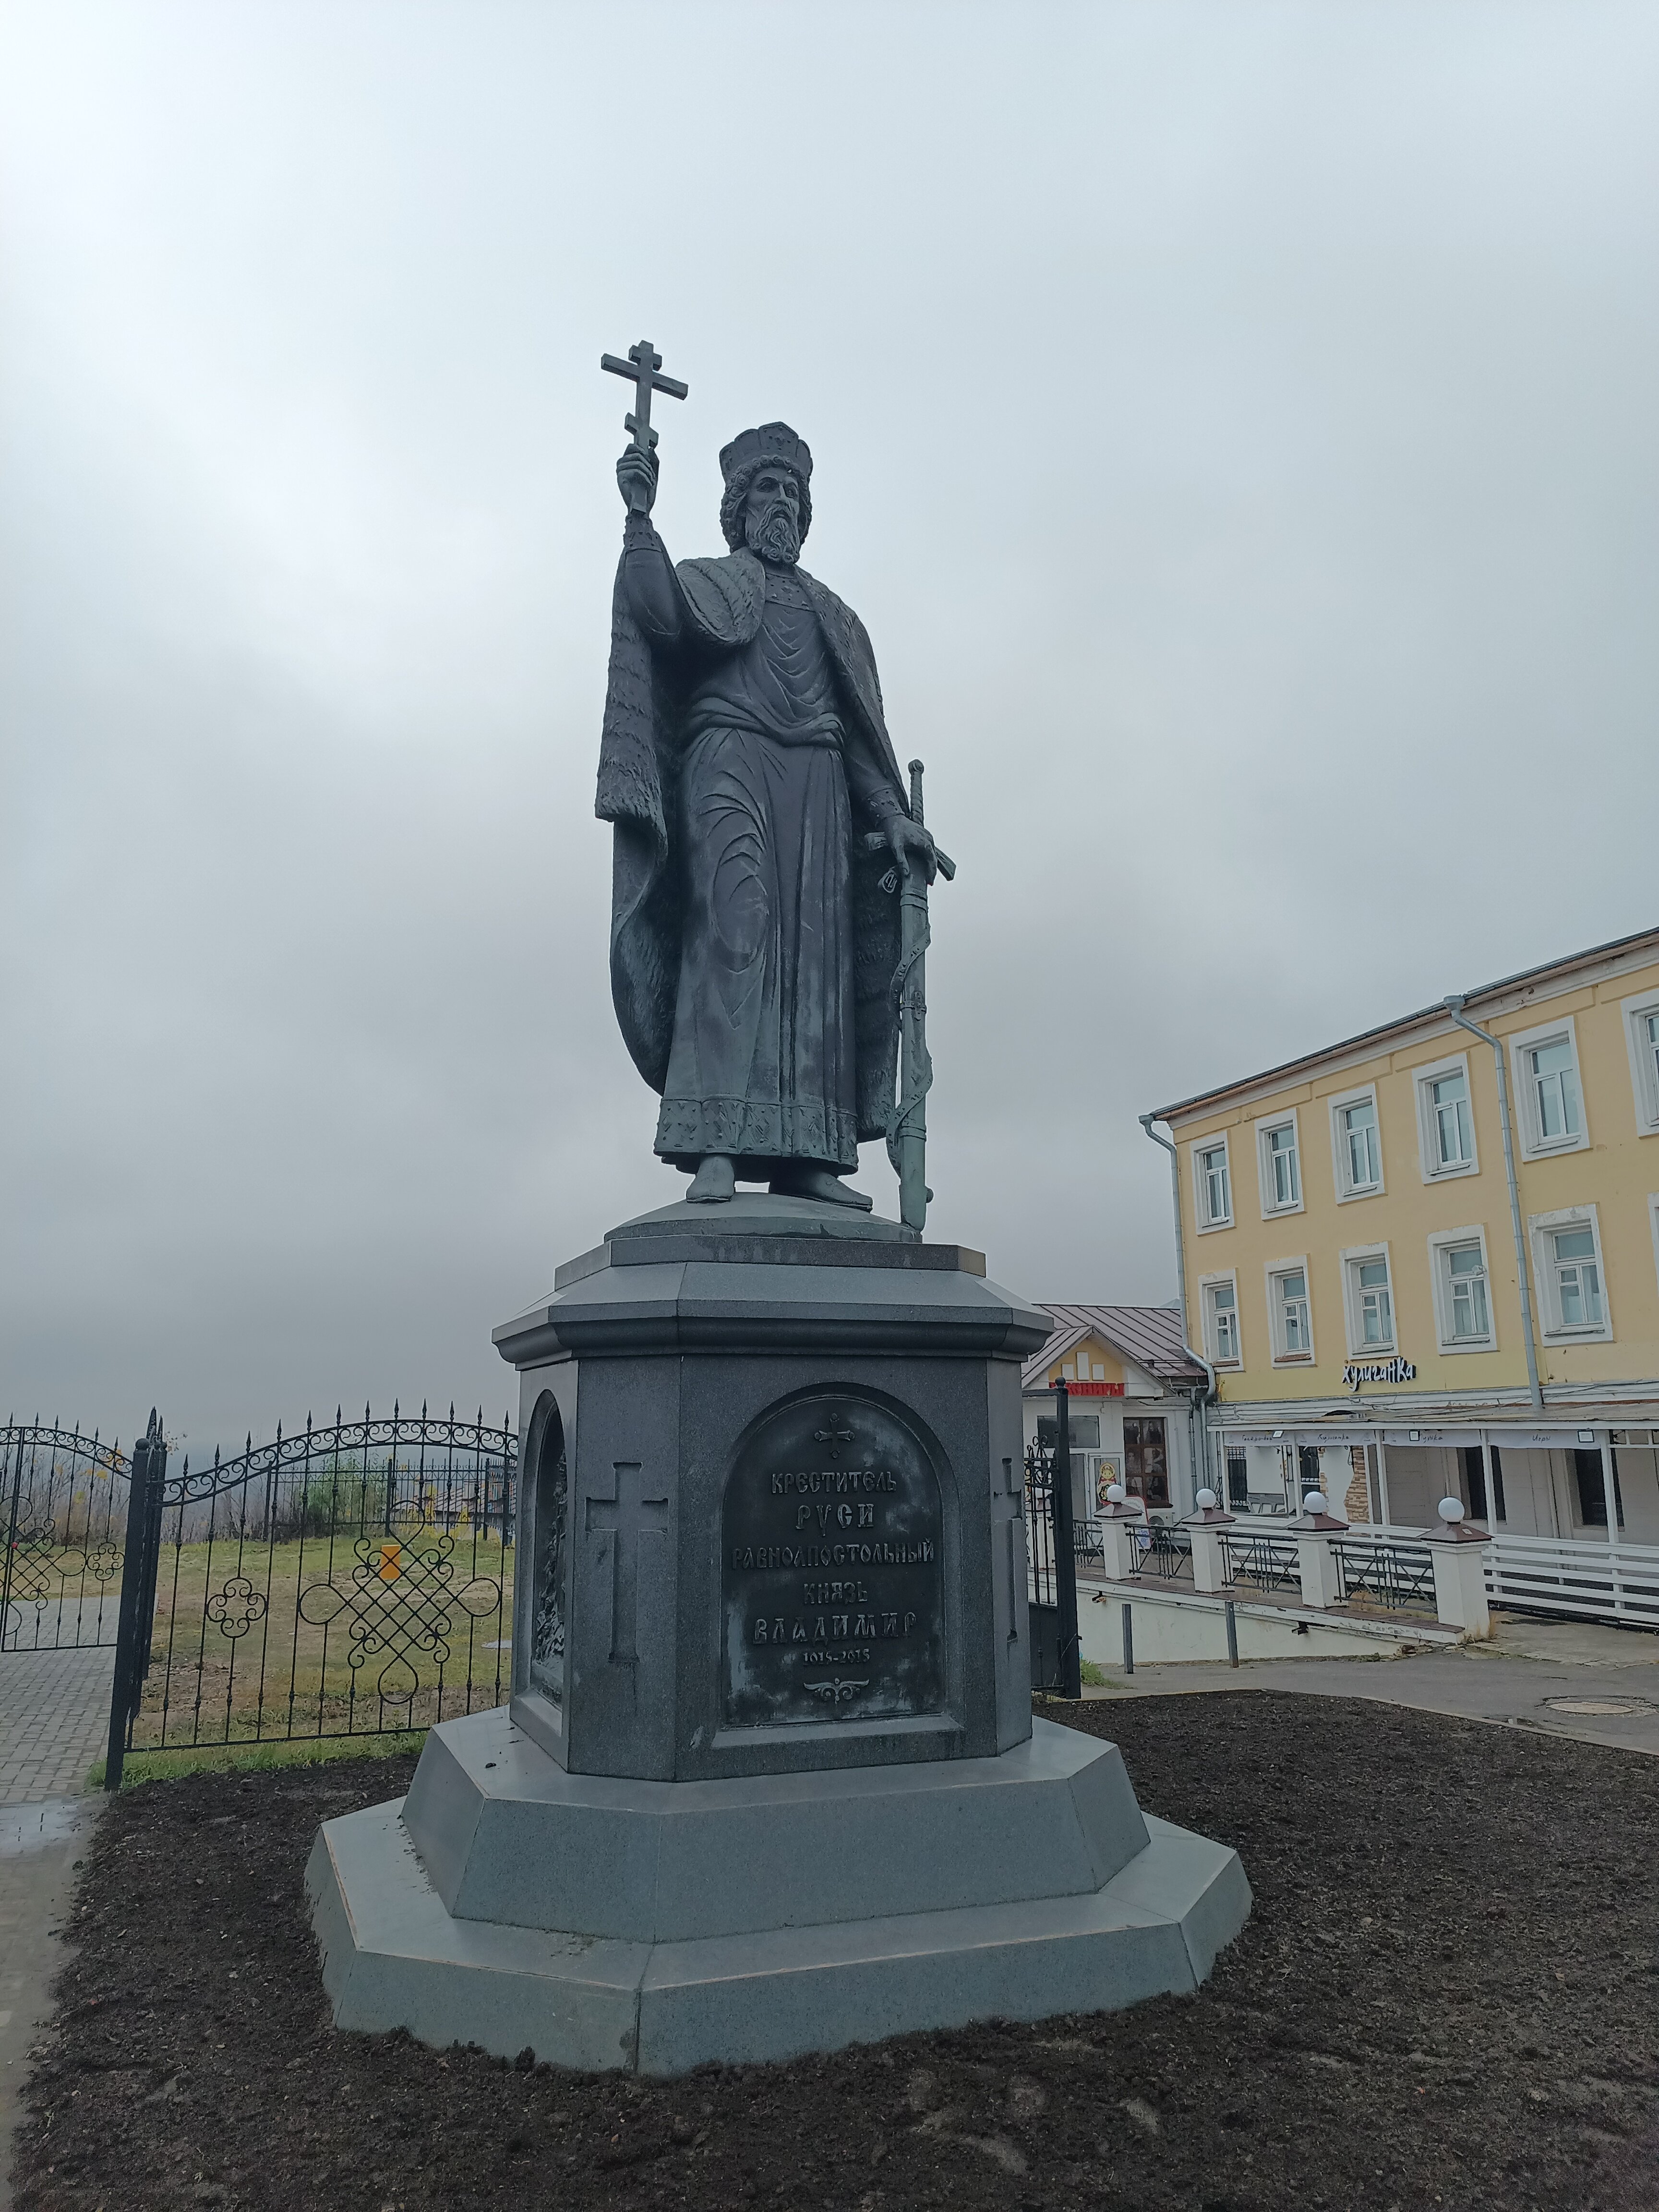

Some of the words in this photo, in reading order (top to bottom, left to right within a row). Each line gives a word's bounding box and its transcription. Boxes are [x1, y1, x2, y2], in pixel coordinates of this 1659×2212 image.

[771, 1471, 897, 1494] КРЕСТИТЕЛЬ
[795, 1503, 874, 1537] РУСИ
[732, 1538, 935, 1569] РАВНОАПОСТОЛЬНЫЙ
[803, 1581, 868, 1605] КНЯЗЬ
[752, 1611, 917, 1646] ВЛАДИМИР
[803, 1648, 870, 1666] 1015-2015
